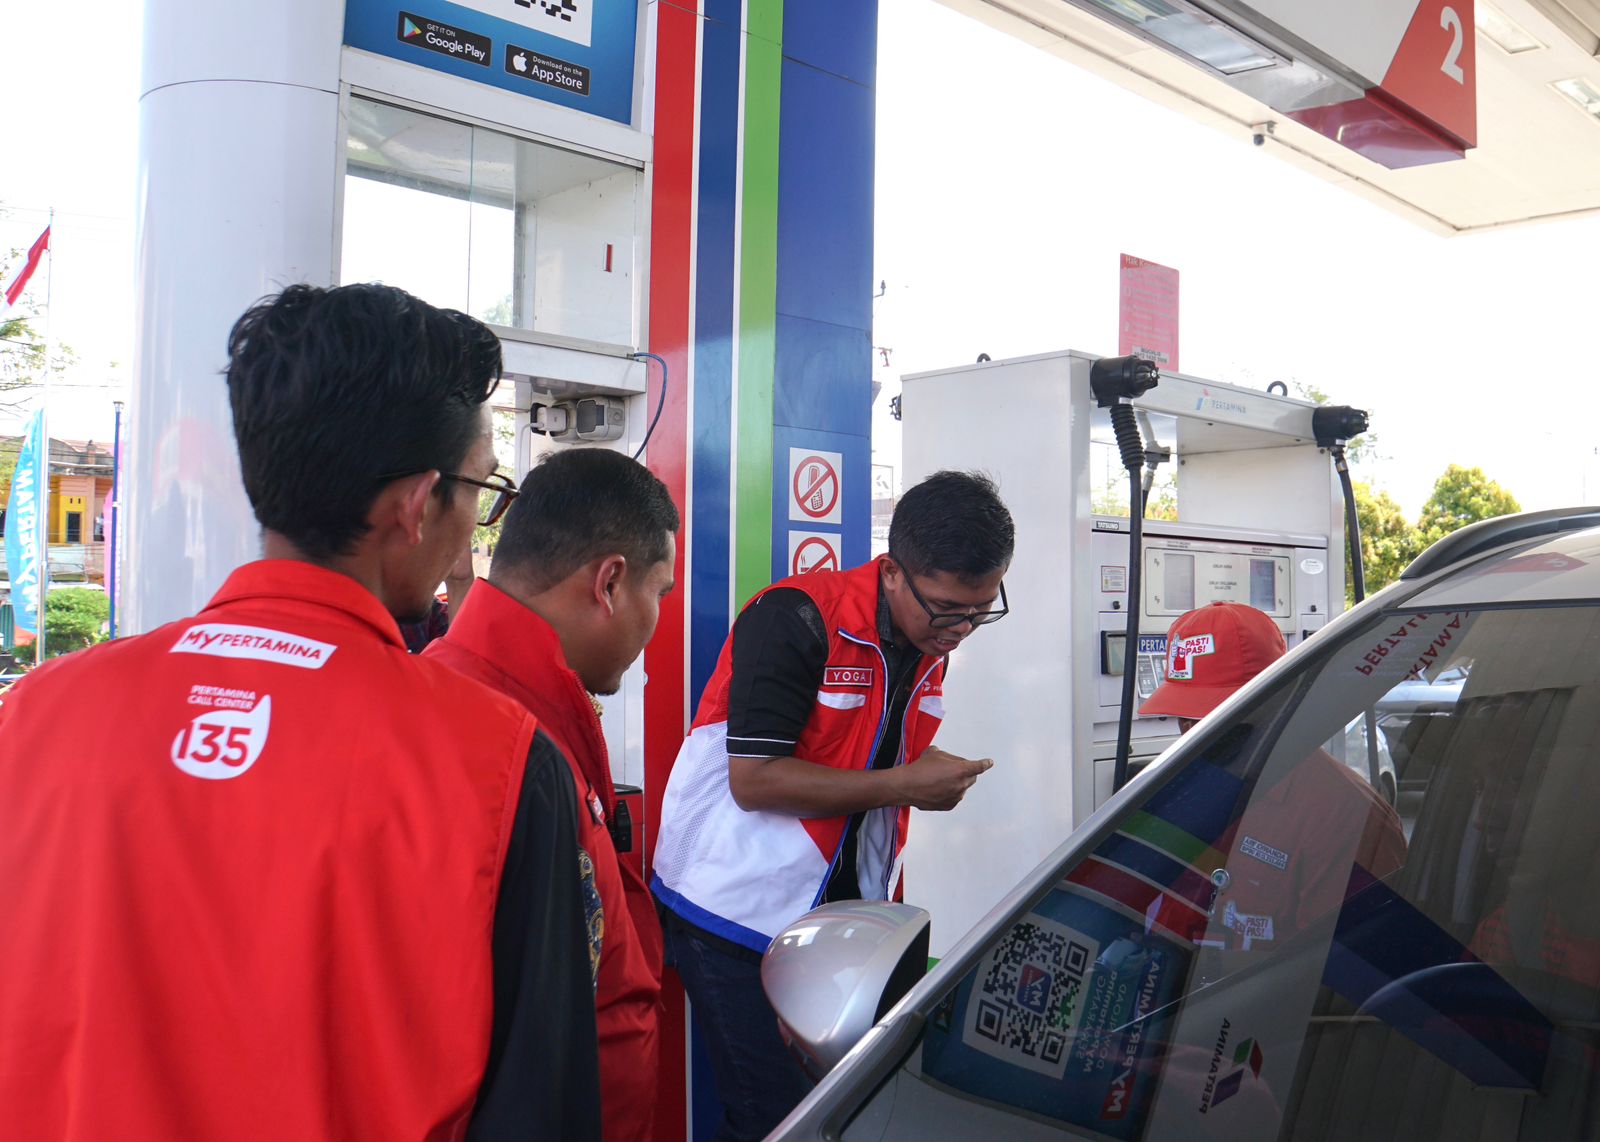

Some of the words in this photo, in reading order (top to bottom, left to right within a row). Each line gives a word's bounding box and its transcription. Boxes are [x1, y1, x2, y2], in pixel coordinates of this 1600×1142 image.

[426, 23, 440, 33] GET
[445, 29, 456, 37] ON
[426, 32, 464, 53] Google
[465, 44, 486, 61] Play
[1440, 6, 1464, 85] 2
[532, 55, 562, 71] Download
[563, 64, 572, 73] on
[573, 67, 583, 77] the
[531, 65, 554, 83] App
[556, 71, 583, 89] Store
[1185, 637, 1209, 648] PASTI
[1186, 645, 1206, 656] PAS!
[833, 671, 866, 681] YOGA
[190, 685, 256, 700] PERTAMINA
[187, 694, 213, 706] CALL
[214, 697, 254, 710] CENTER
[177, 722, 253, 768] 135
